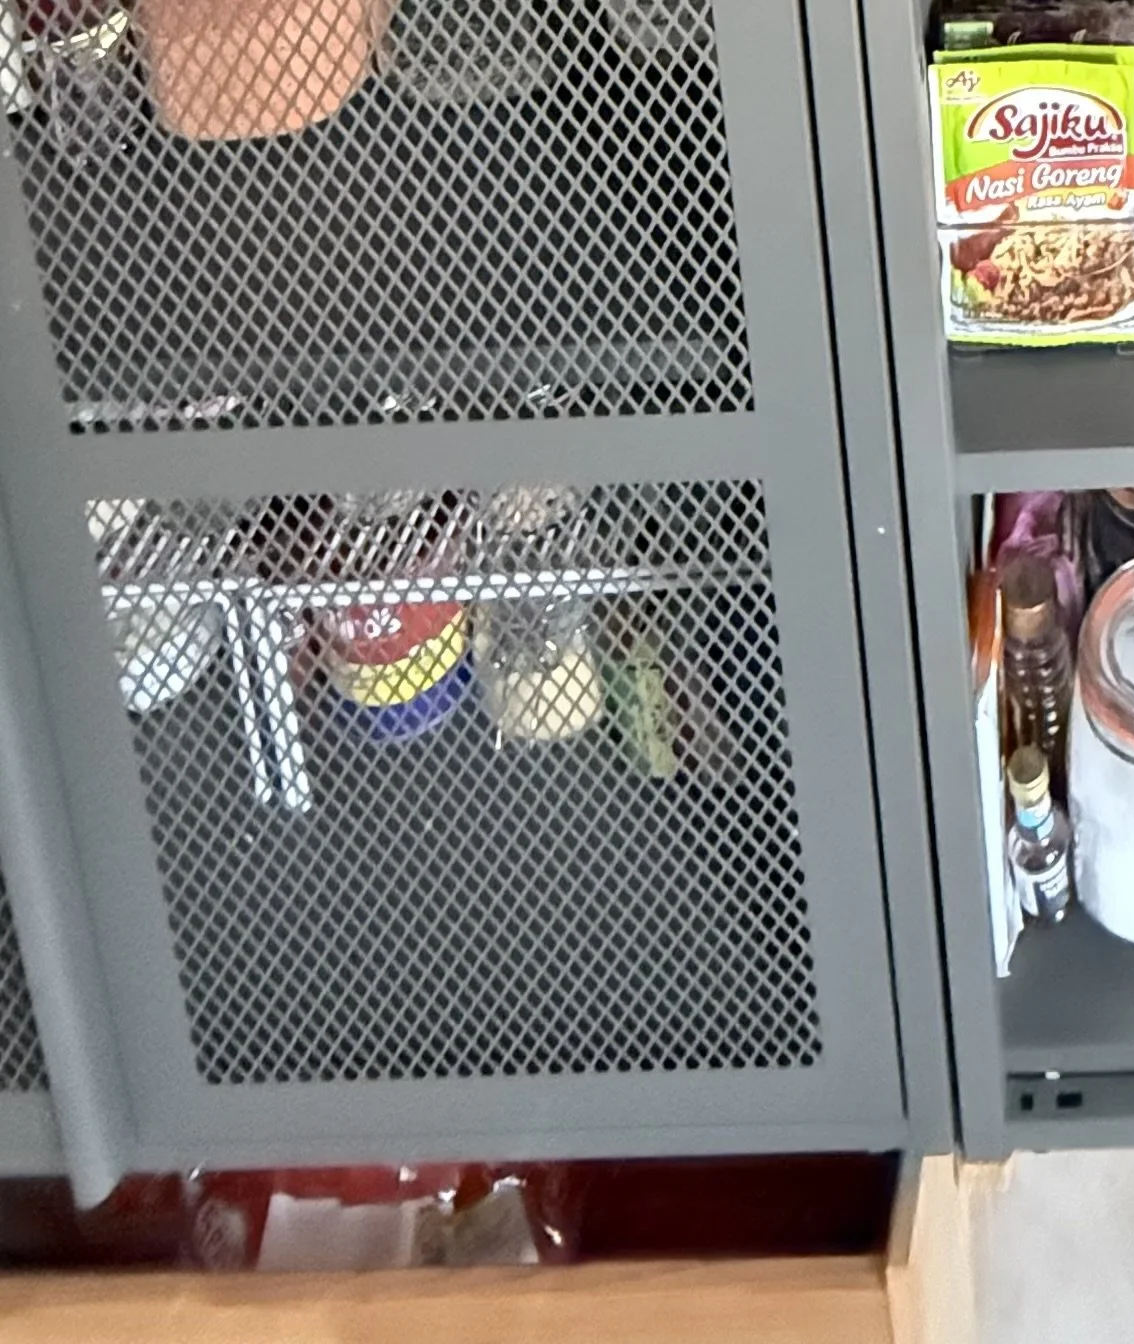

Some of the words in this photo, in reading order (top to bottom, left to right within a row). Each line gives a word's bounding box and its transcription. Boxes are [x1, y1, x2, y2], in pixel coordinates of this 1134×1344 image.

[988, 101, 1107, 159] Sajiku
[964, 167, 1026, 204] Nasi
[1031, 162, 1123, 190] Goreng
